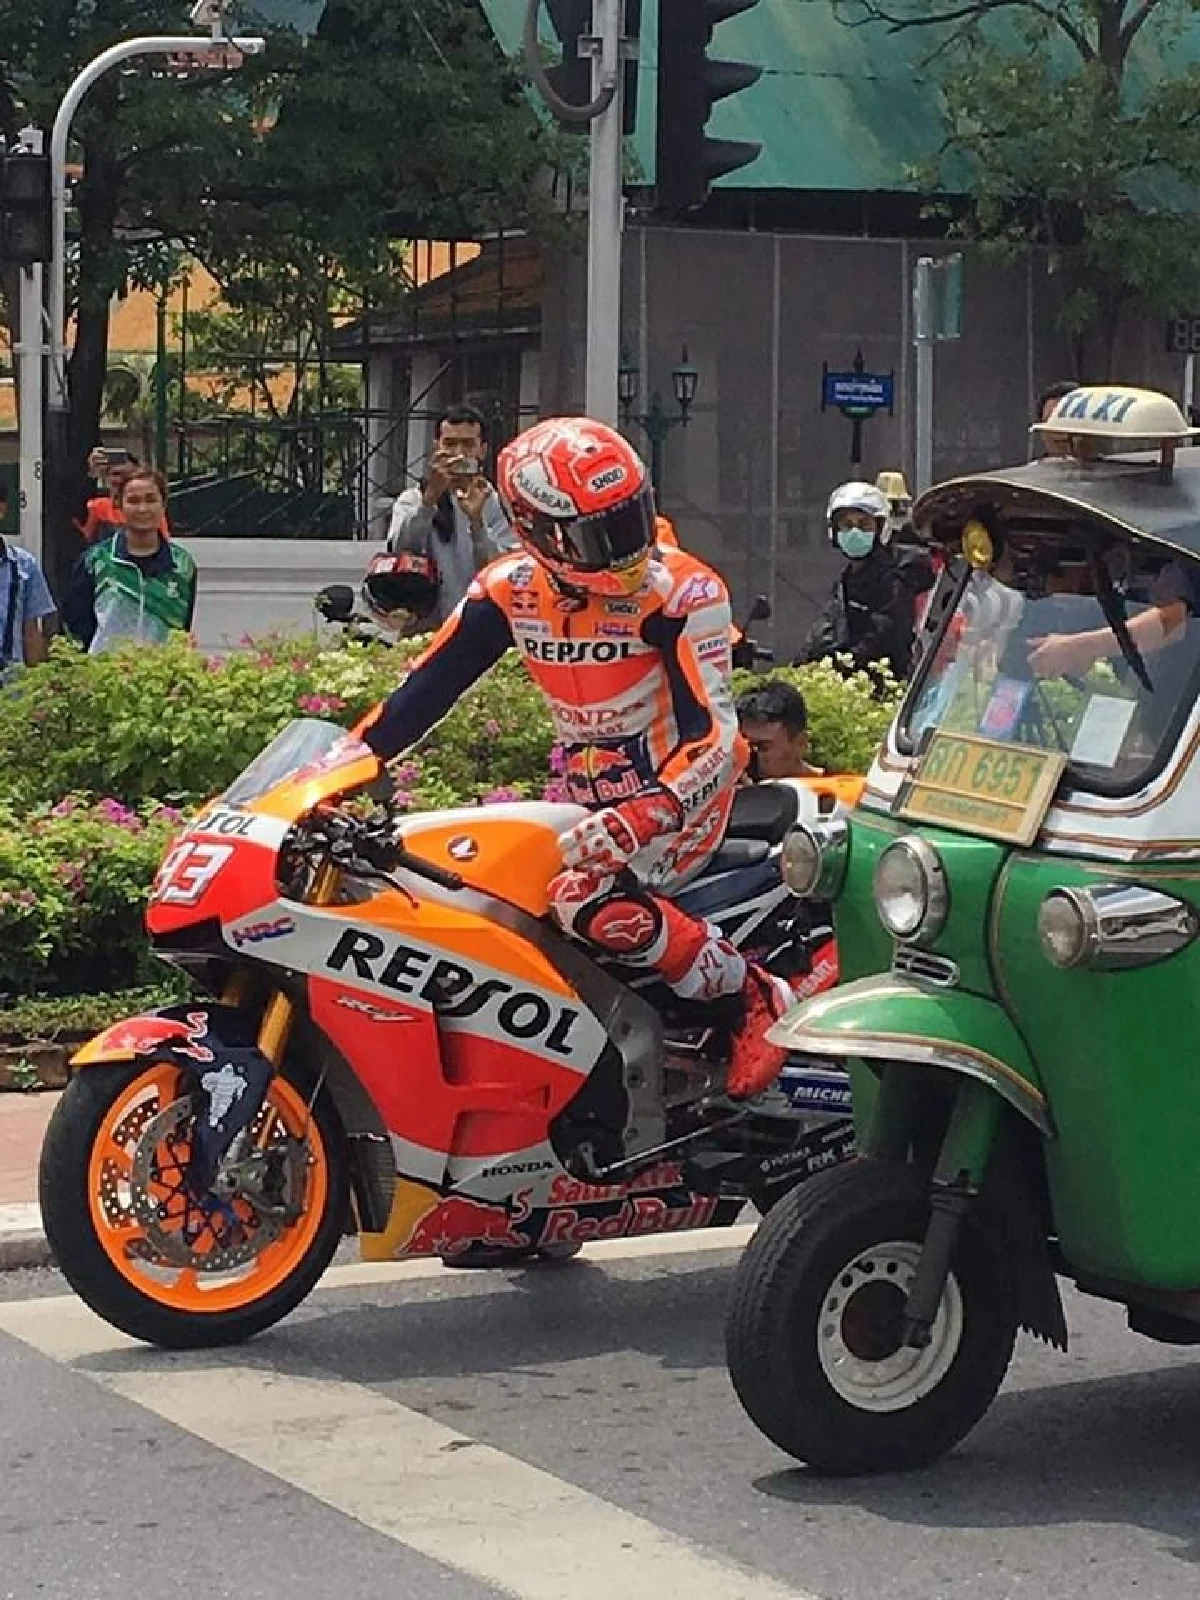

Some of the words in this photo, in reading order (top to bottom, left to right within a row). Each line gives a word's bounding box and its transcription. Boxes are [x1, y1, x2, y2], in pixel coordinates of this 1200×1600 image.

[1058, 392, 1137, 423] TAXI
[525, 638, 631, 662] REPSOL
[326, 927, 579, 1055] REPSOL
[482, 1160, 554, 1178] HONDA
[536, 1198, 633, 1248] Red
[627, 1190, 721, 1238] Bull
